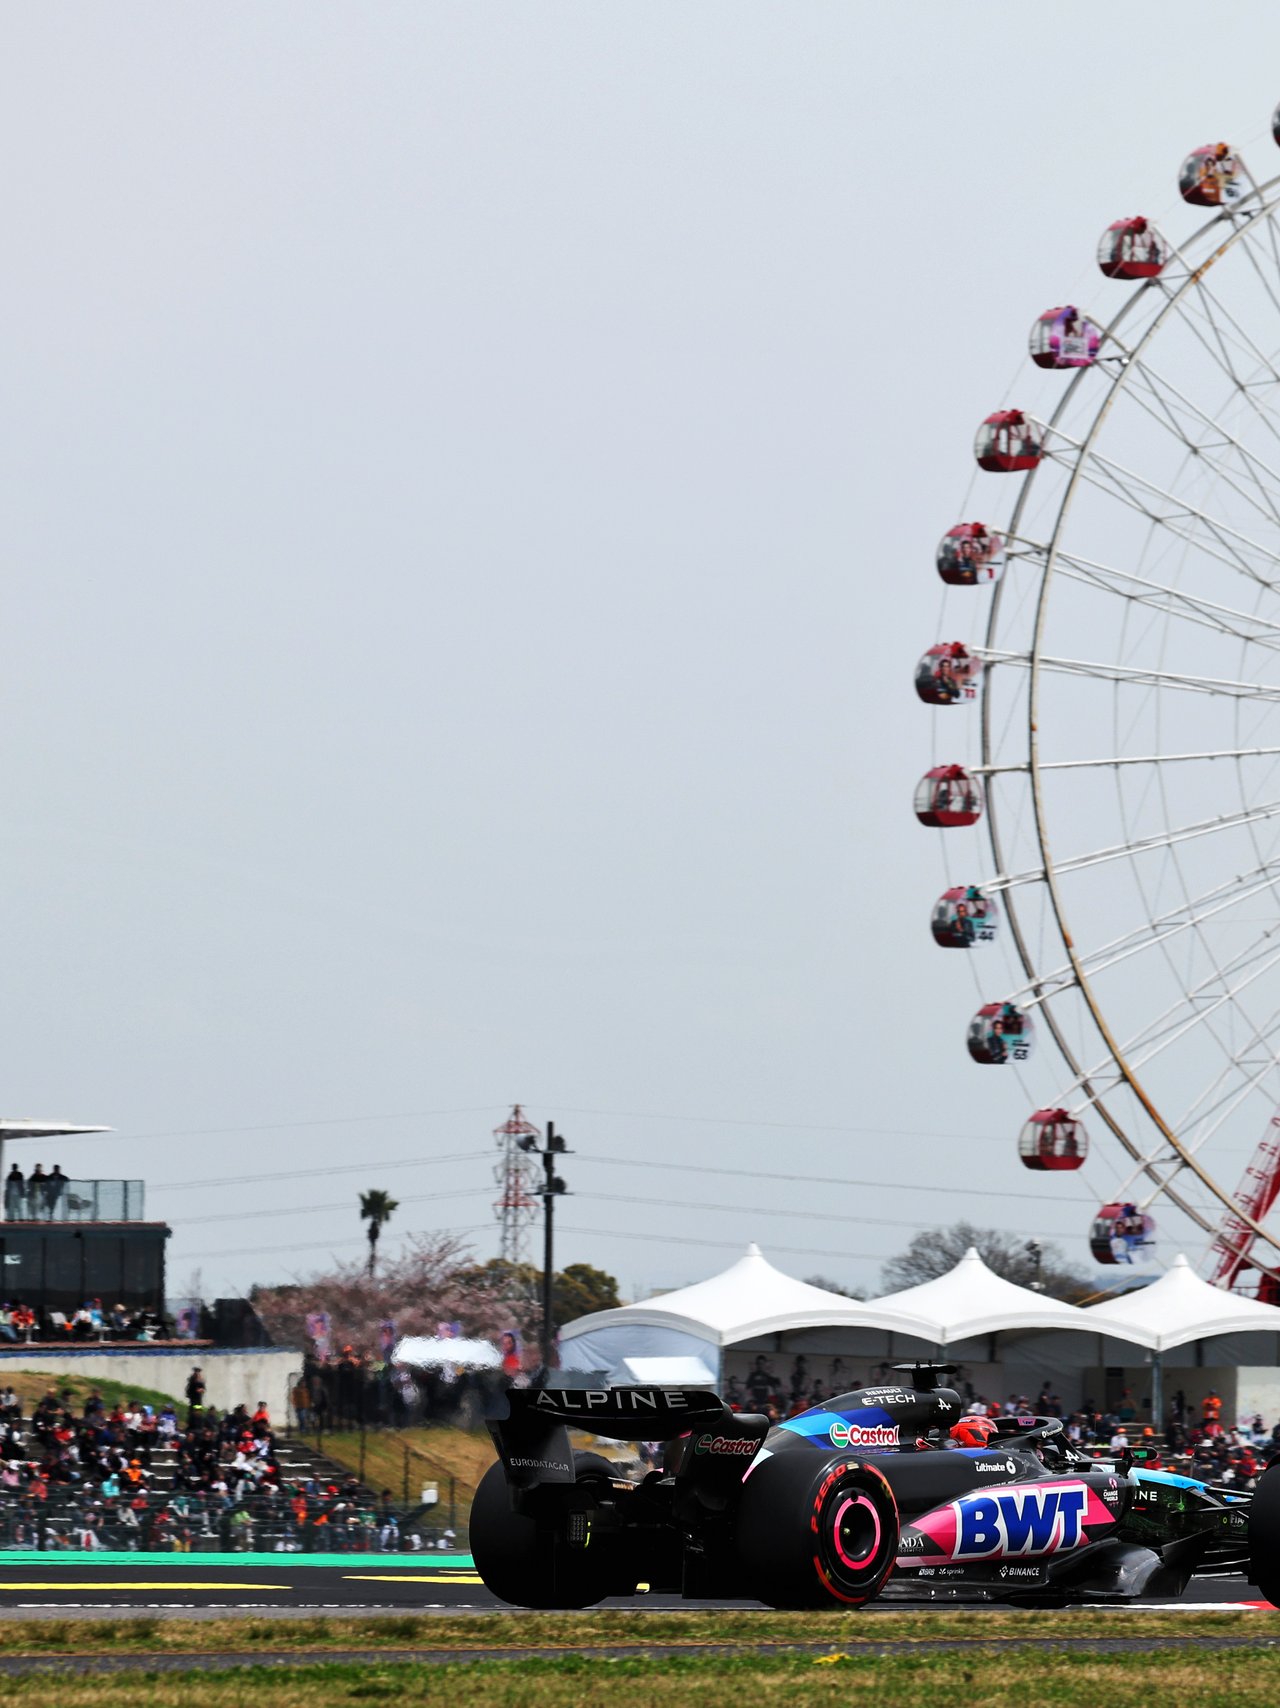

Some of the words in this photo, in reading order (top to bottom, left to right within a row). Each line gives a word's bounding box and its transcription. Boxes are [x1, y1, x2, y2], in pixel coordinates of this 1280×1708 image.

[537, 1390, 689, 1409] ALPINE
[862, 1394, 916, 1406] E-TECH
[865, 1388, 902, 1396] RENAULT
[848, 1424, 900, 1446] Castrol
[709, 1437, 761, 1455] Castrol
[510, 1458, 570, 1472] EURODATACAR
[976, 1463, 1006, 1472] ultimate
[810, 1515, 818, 1534] P
[814, 1463, 846, 1514] ZERO
[954, 1487, 1086, 1557] BWT
[1009, 1567, 1040, 1576] BINANCE
